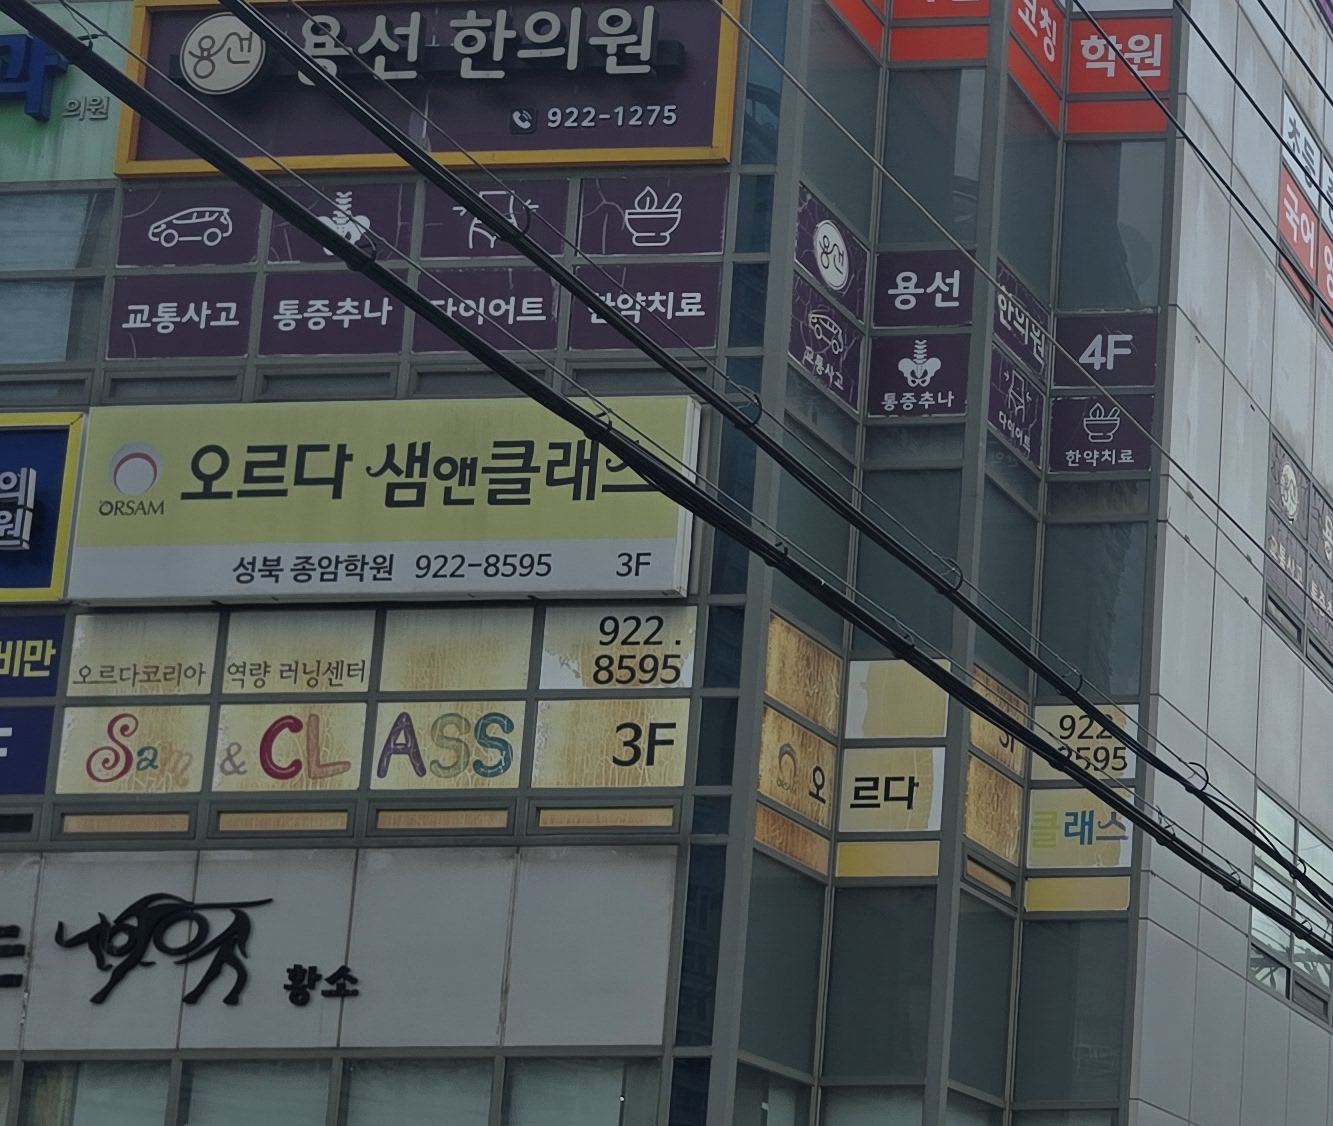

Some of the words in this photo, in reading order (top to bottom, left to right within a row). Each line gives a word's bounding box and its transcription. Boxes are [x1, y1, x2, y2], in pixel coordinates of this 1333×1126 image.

[299, 8, 420, 86] 용선
[450, 5, 658, 80] 한의원
[1080, 33, 1162, 77] 학원
[62, 95, 110, 122] 의원
[547, 105, 678, 129] 922-1275
[1283, 183, 1315, 270] 국어
[888, 270, 960, 310] 용선
[121, 301, 240, 331] 교통사고
[272, 298, 392, 331] 통증추나
[1079, 334, 1133, 370] 4F
[881, 391, 954, 411] 통증추나
[180, 442, 353, 501] 오르다
[366, 438, 664, 509] 샘앤클래스
[1065, 449, 1134, 467] 한약치료
[99, 499, 165, 517] ORSAM
[233, 555, 283, 584] 성북
[291, 553, 395, 582] 종암학원
[415, 553, 553, 580] 922-8595
[615, 552, 652, 578] 3F
[73, 664, 206, 688] 오르다코리아
[226, 661, 272, 689] 역량
[279, 660, 367, 687] 러닝센터
[593, 654, 682, 687] 8595
[259, 711, 515, 782] CLASS
[612, 722, 677, 768] 3F
[283, 965, 359, 1006] 황소
